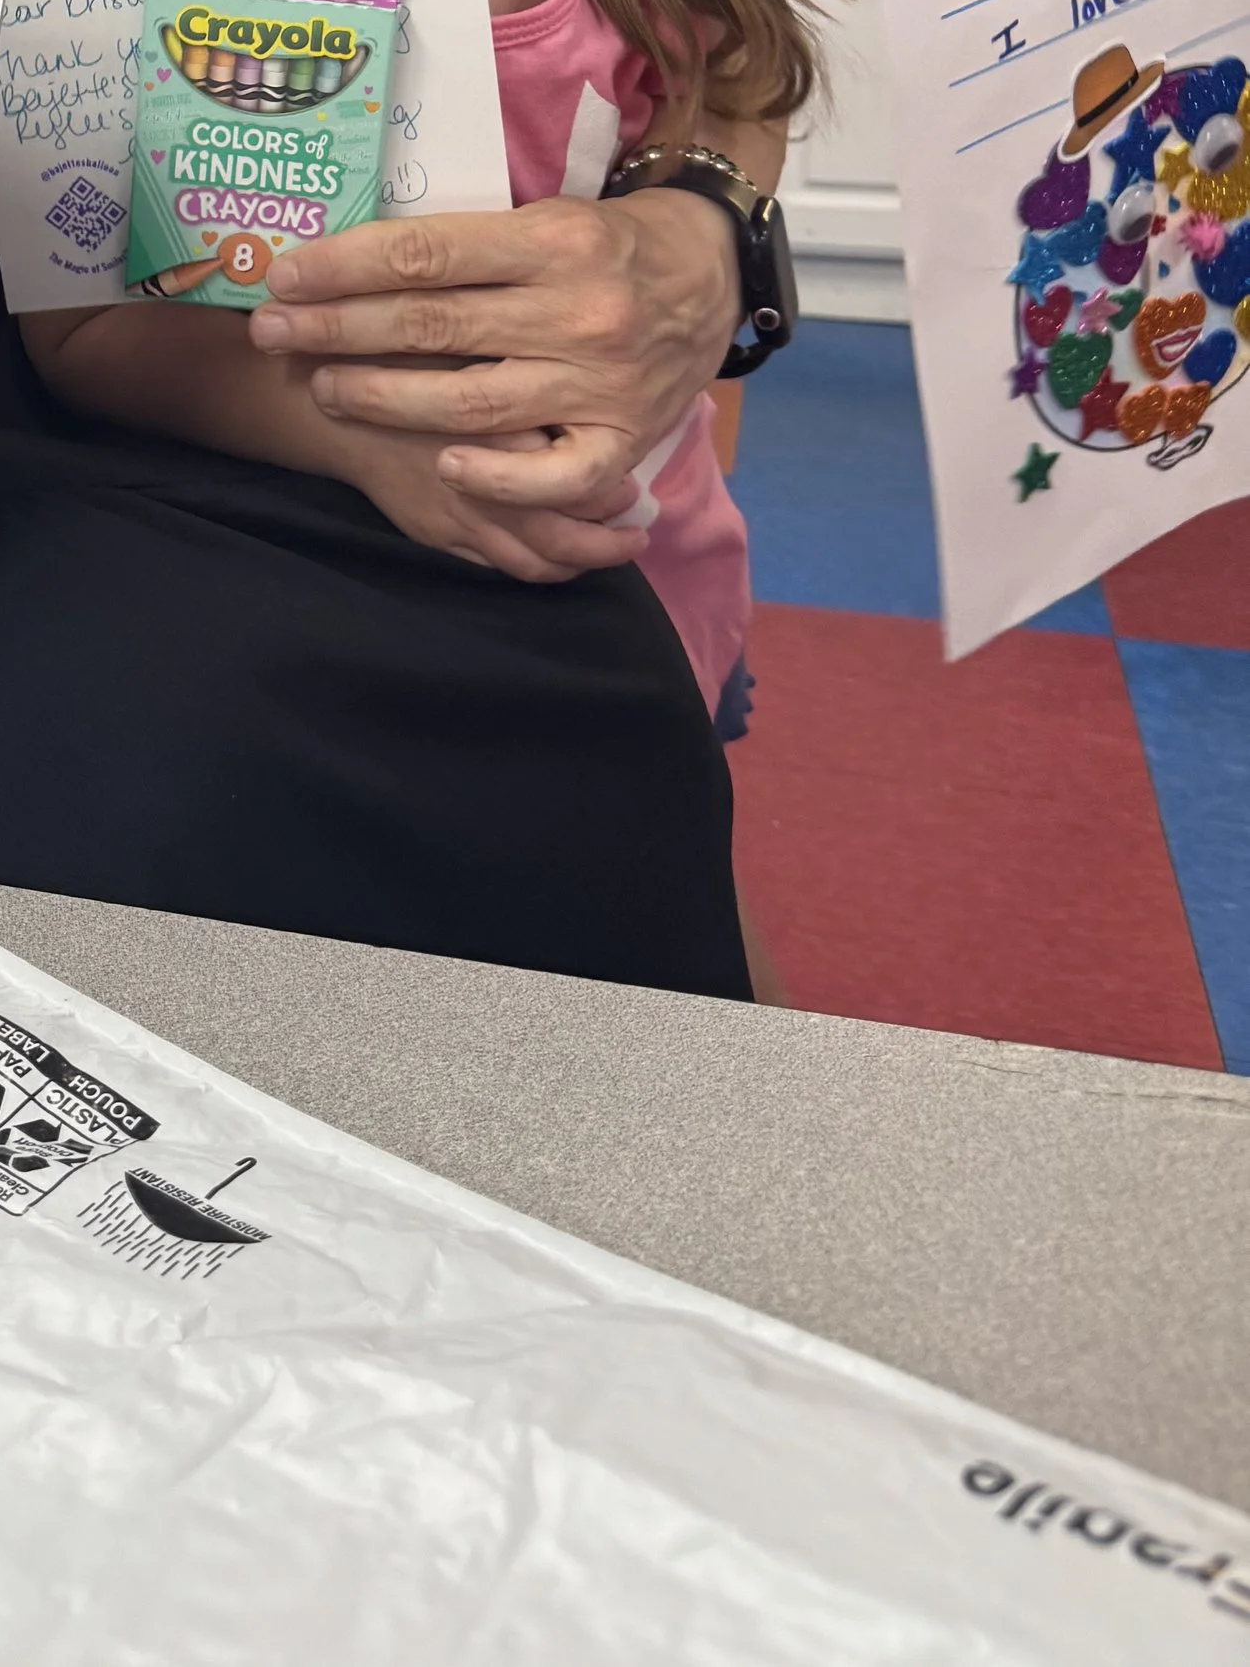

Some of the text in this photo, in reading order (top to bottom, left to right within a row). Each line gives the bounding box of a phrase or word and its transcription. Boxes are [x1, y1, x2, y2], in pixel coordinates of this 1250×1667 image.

[177, 6, 355, 58] Crayola
[991, 18, 1027, 60] I
[191, 122, 329, 160] COLORS of
[178, 192, 325, 236] CRAYONS
[232, 241, 255, 272] 8
[45, 1088, 131, 1147] PLASTIC
[67, 1074, 142, 1133] POUCH
[128, 1166, 273, 1240] MOISTURE RESISTANT
